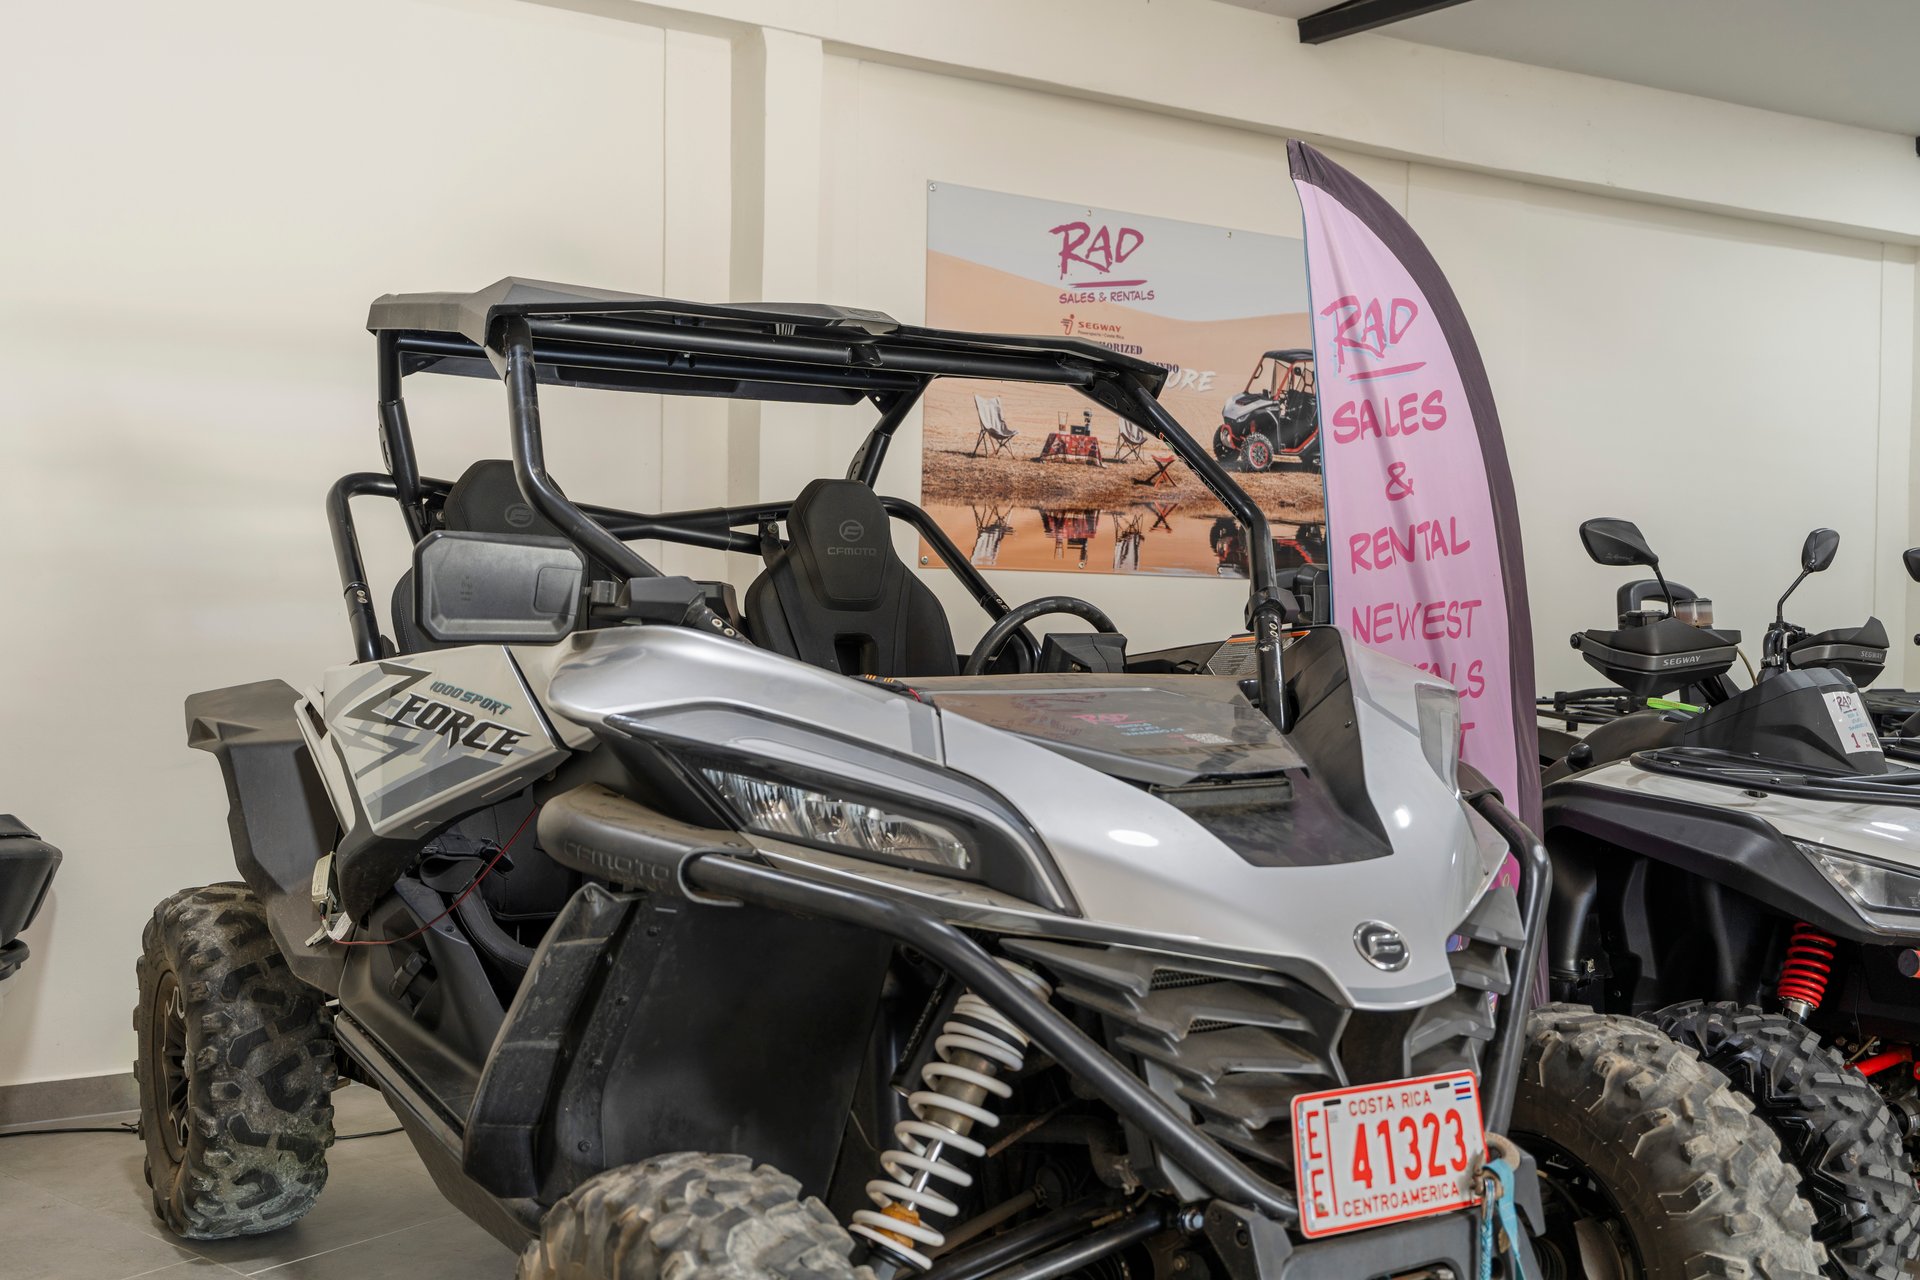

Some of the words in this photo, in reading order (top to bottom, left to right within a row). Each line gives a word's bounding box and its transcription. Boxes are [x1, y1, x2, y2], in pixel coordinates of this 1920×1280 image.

[1048, 221, 1145, 280] RAD
[1059, 292, 1096, 304] SALES
[1099, 292, 1107, 302] &
[1110, 290, 1155, 302] RENTALS
[1078, 321, 1122, 333] SEGWAY
[1320, 295, 1419, 373] RAD
[1332, 389, 1447, 444] SALES
[1385, 461, 1414, 501] &
[827, 546, 877, 556] CFMOTO
[1349, 516, 1471, 574] RENTAL
[1352, 599, 1482, 644] NEWEST
[1663, 655, 1701, 666] SEGWAY
[430, 681, 464, 699] 1000
[459, 691, 512, 716] SPORT
[1348, 1097, 1395, 1116] COSTA
[1401, 1090, 1432, 1109] RICA
[1352, 1108, 1467, 1190] 41323
[1343, 1181, 1460, 1218] CENTROAMERICA
